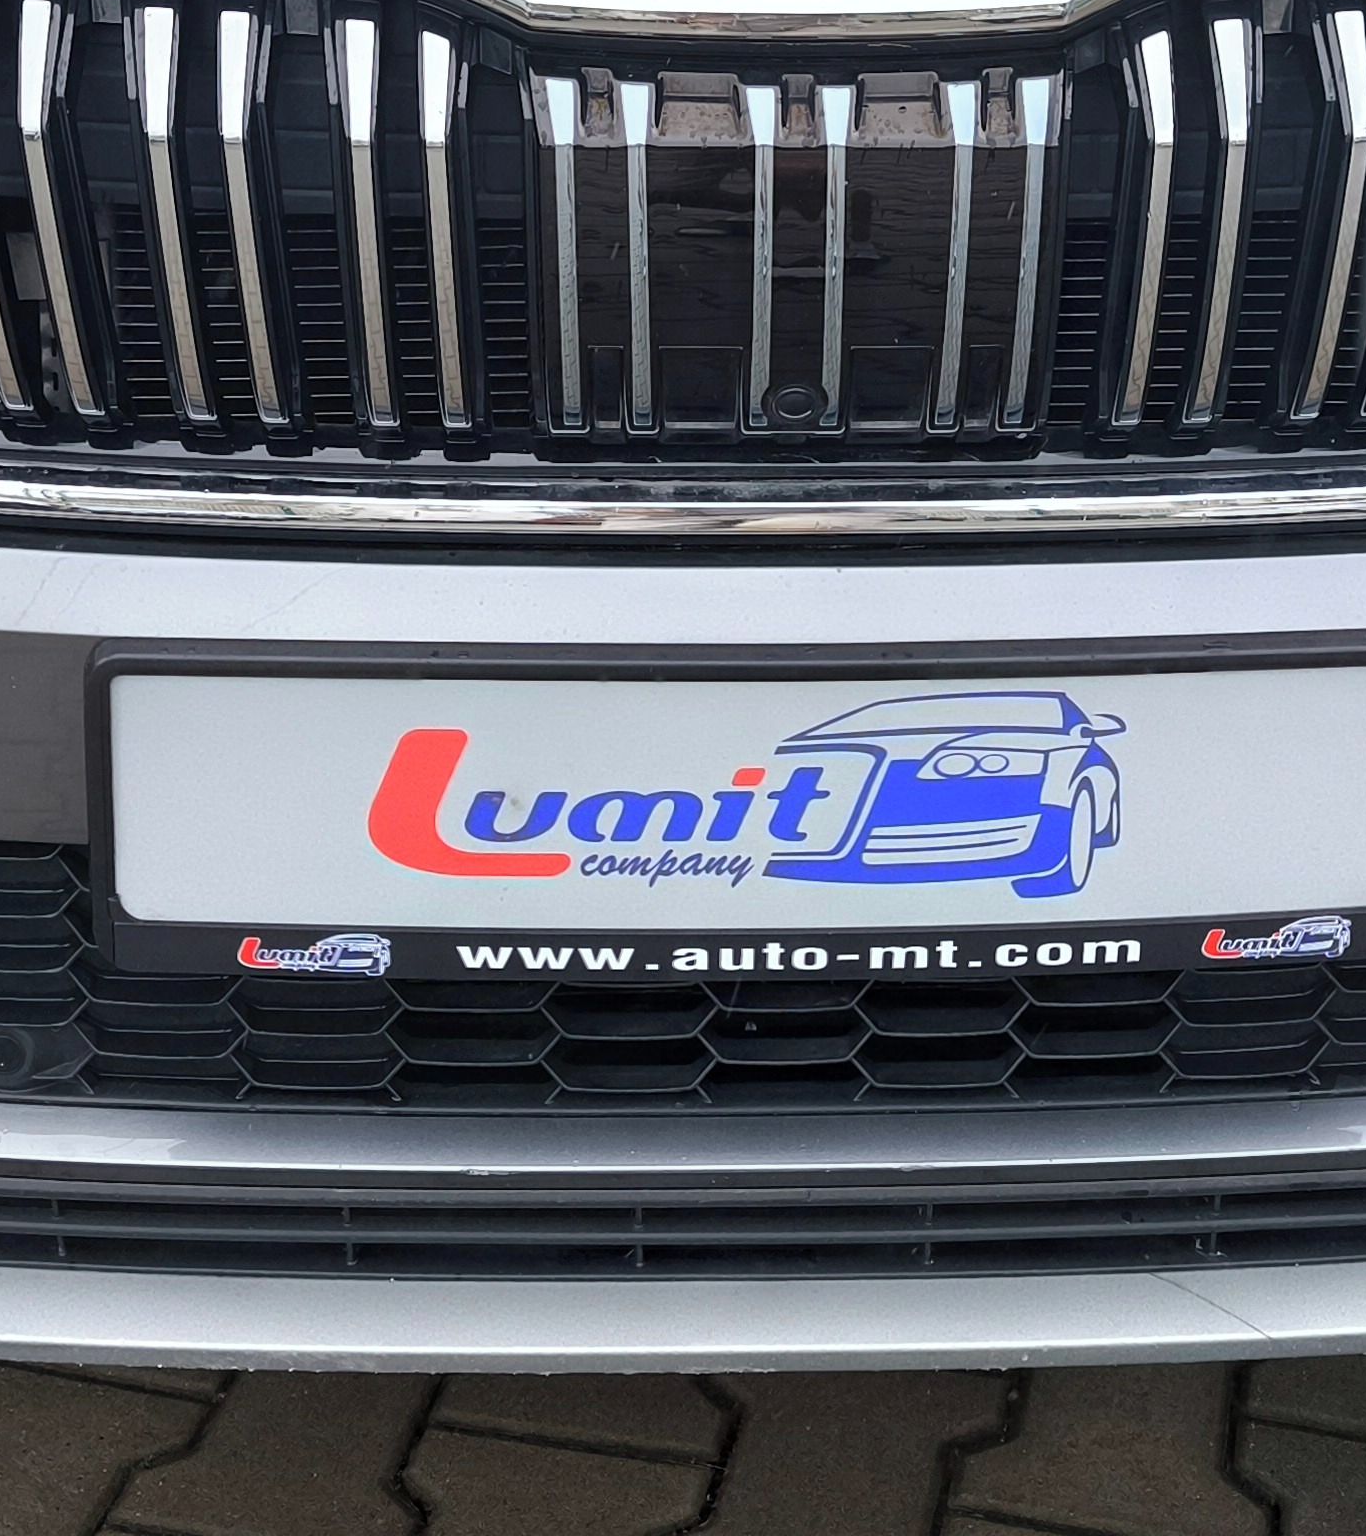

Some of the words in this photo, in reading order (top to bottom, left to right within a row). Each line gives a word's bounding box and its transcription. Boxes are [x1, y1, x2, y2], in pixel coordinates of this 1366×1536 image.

[367, 728, 831, 877] Lumit
[579, 849, 754, 887] company
[237, 936, 332, 969] Lumit
[455, 938, 1142, 971] www.auto-mt.com
[1201, 928, 1294, 959] Lumit
